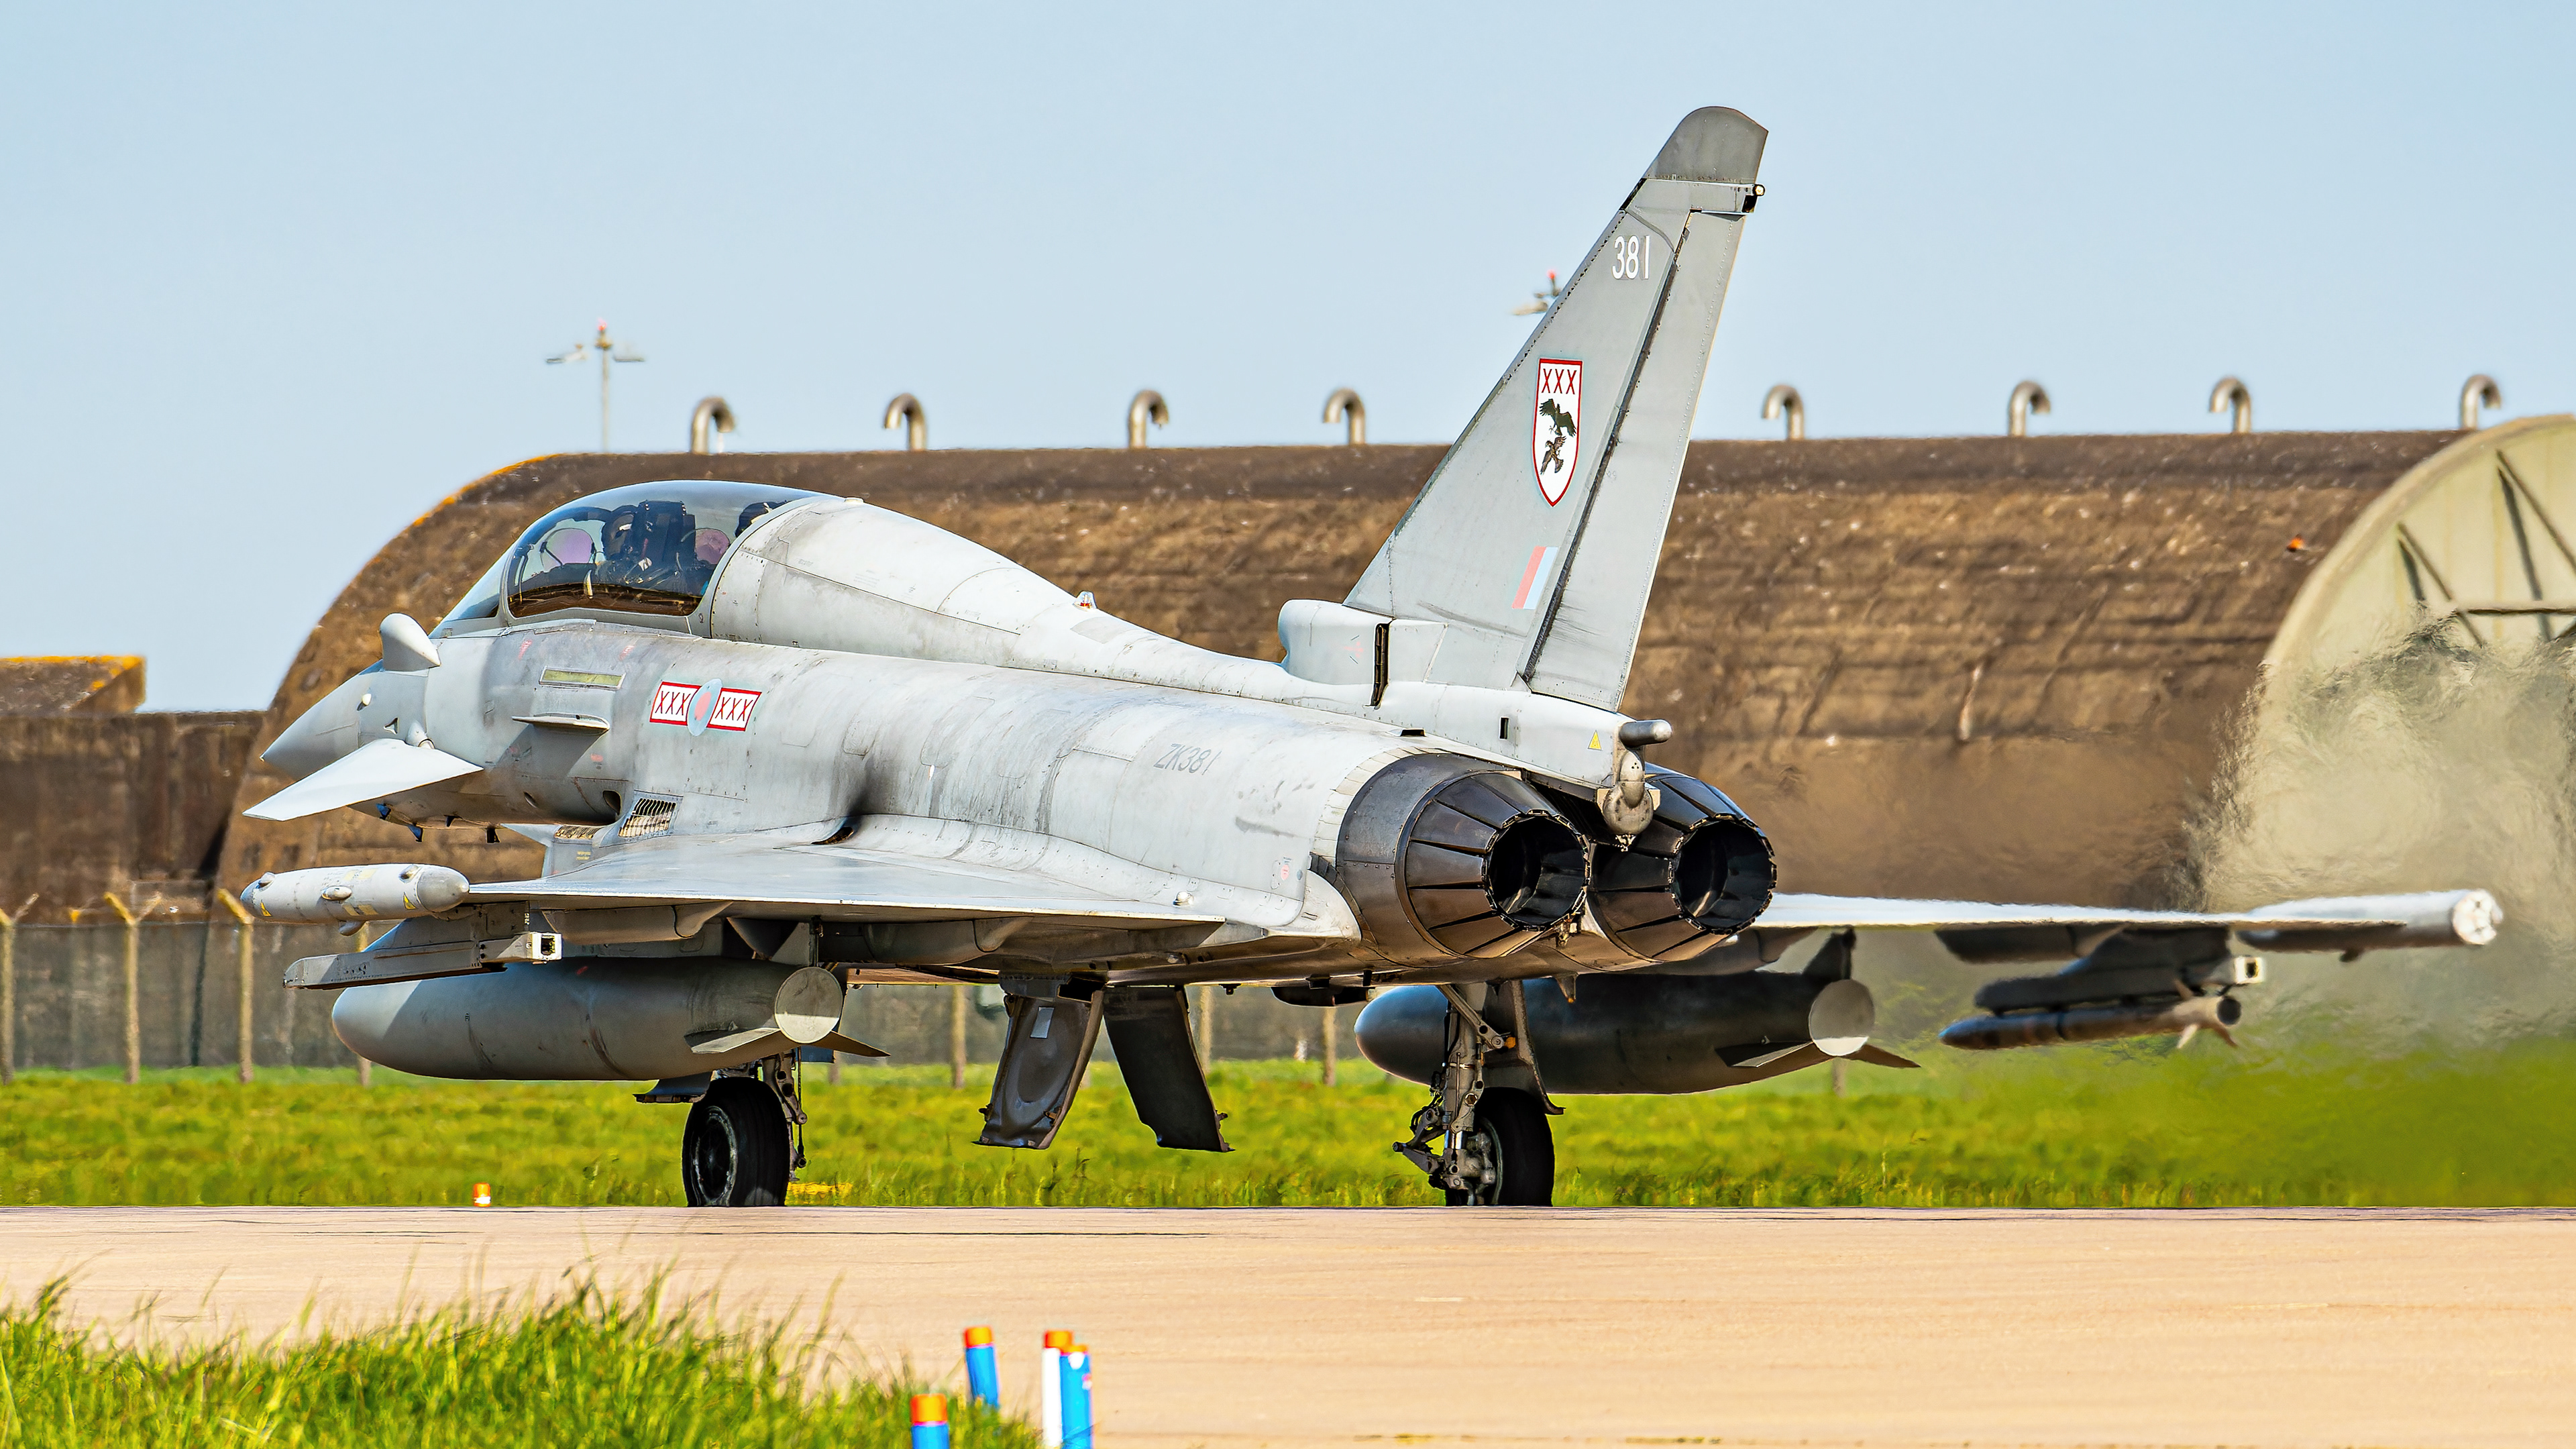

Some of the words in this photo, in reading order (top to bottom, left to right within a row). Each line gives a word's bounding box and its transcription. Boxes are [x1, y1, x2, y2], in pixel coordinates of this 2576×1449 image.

[1612, 235, 1650, 279] 381
[1541, 368, 1577, 394] XXX
[655, 690, 691, 716] XXX
[714, 696, 753, 722] XXX
[1153, 743, 1222, 775] ZK381
